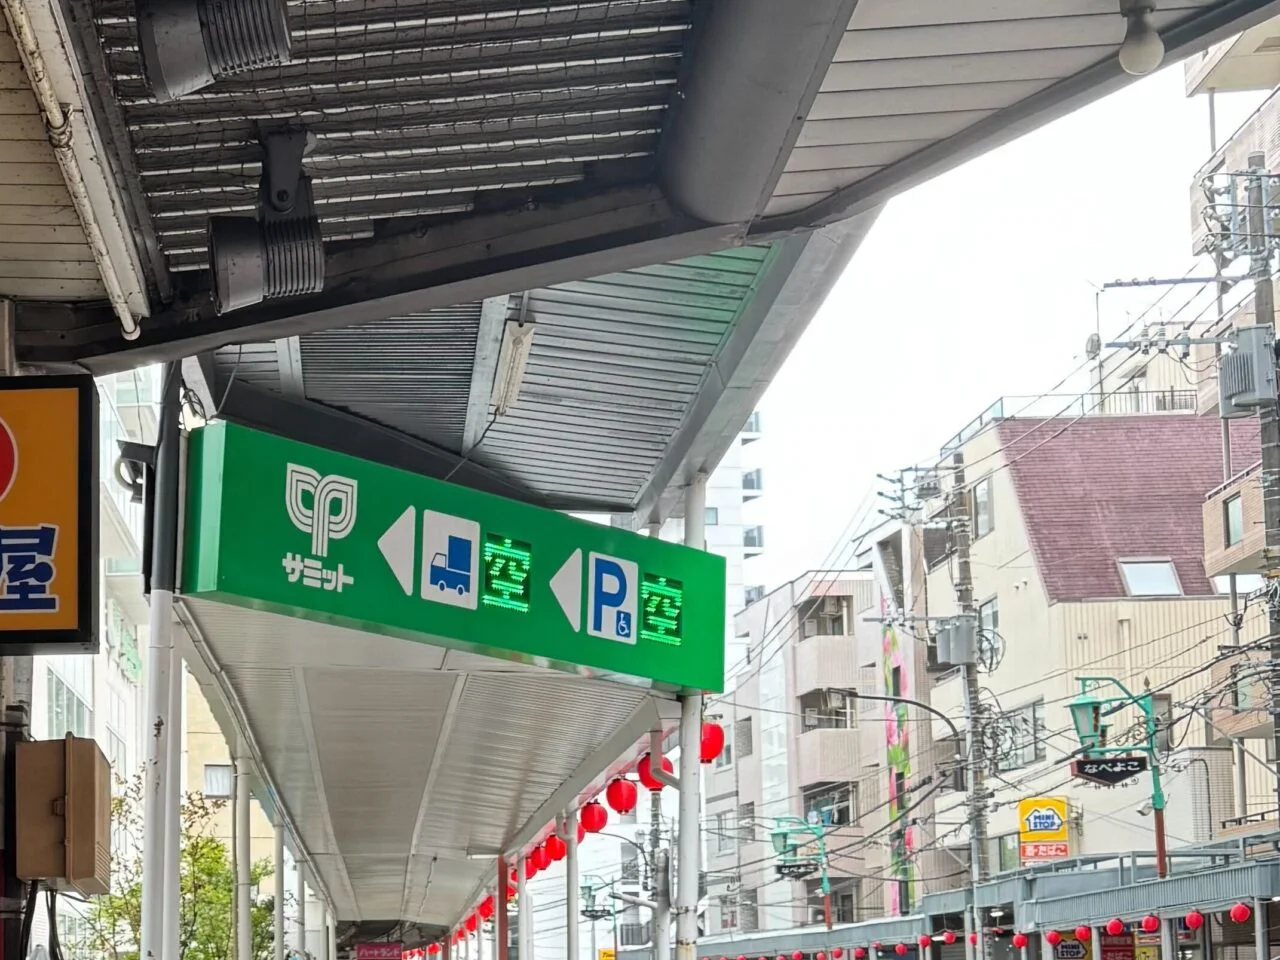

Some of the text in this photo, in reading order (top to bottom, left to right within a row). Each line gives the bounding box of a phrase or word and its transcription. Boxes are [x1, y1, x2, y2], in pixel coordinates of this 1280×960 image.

[282, 552, 354, 592] サミット
[482, 538, 532, 613] 空
[593, 558, 627, 631] P
[640, 577, 682, 646] 空
[1084, 761, 1141, 774] なべよこ
[1033, 821, 1057, 829] STOP
